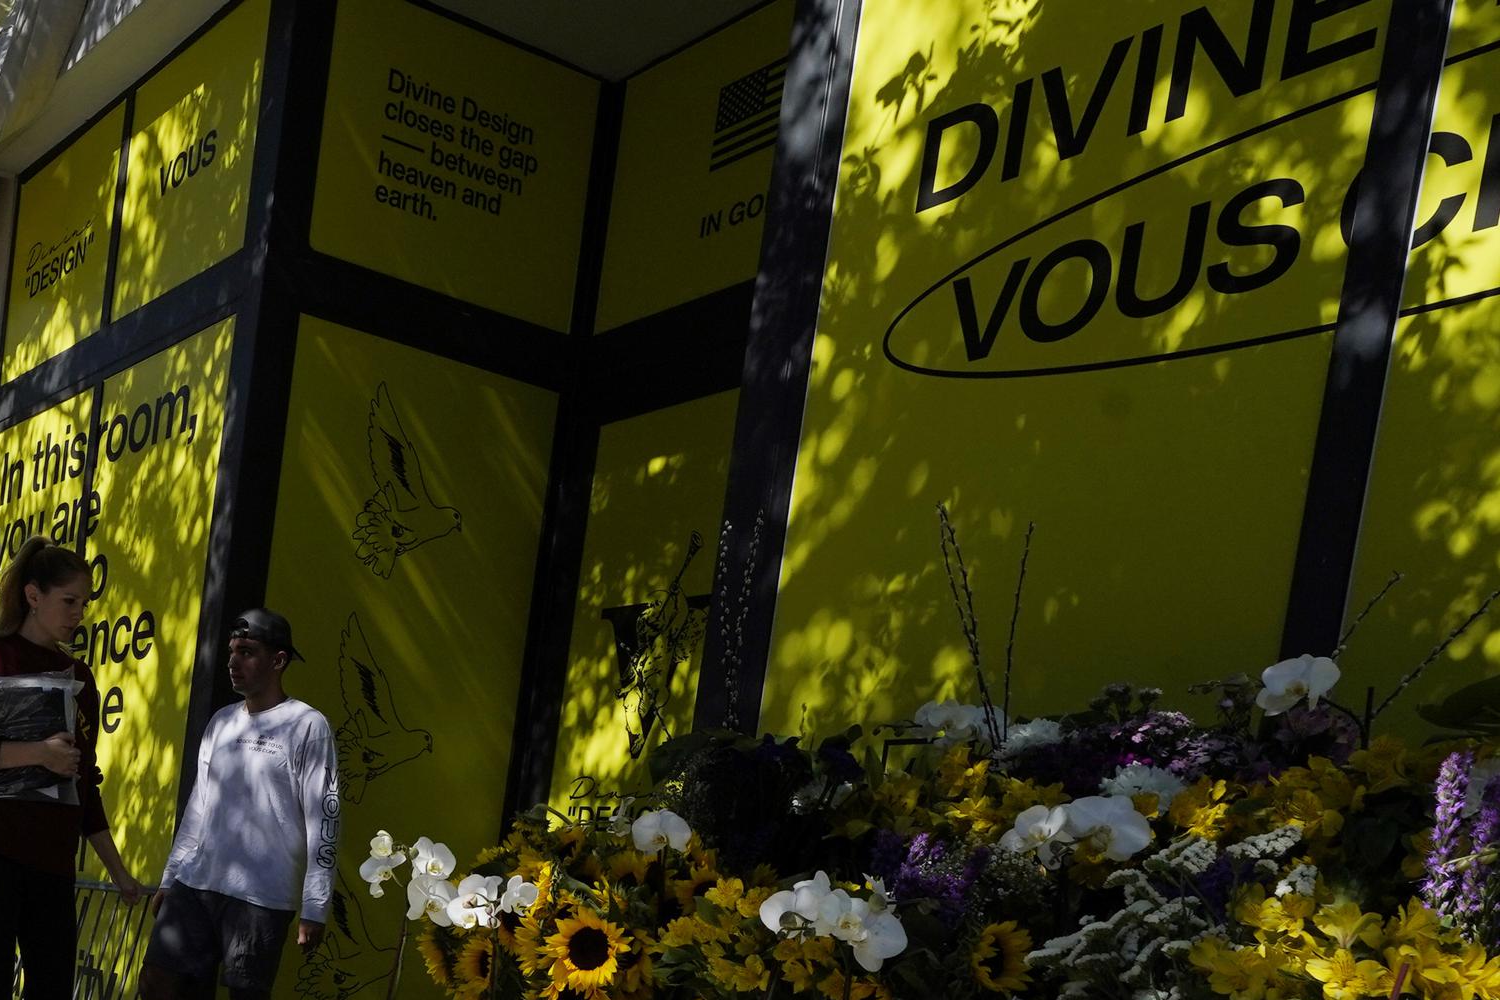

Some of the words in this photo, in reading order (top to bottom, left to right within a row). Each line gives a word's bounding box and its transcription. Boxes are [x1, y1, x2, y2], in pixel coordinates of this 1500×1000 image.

[384, 100, 455, 142] closes
[460, 126, 494, 156] the
[499, 145, 538, 176] gap
[388, 68, 456, 114] Divine
[461, 96, 534, 145] Design
[915, 0, 1379, 214] DIVINE
[158, 129, 218, 196] VOUS
[377, 150, 457, 199] heaven
[461, 187, 502, 216] and
[430, 141, 522, 196] between
[375, 184, 437, 221] earth.
[699, 209, 723, 239] IN
[729, 193, 770, 226] GO
[24, 231, 96, 299] "DESIGN"
[953, 177, 1305, 361] VOUS
[0, 451, 25, 507] In
[32, 423, 87, 494] this
[94, 384, 199, 470] room,
[51, 487, 101, 547] are
[71, 609, 155, 670] ence
[316, 766, 340, 869] VOUS
